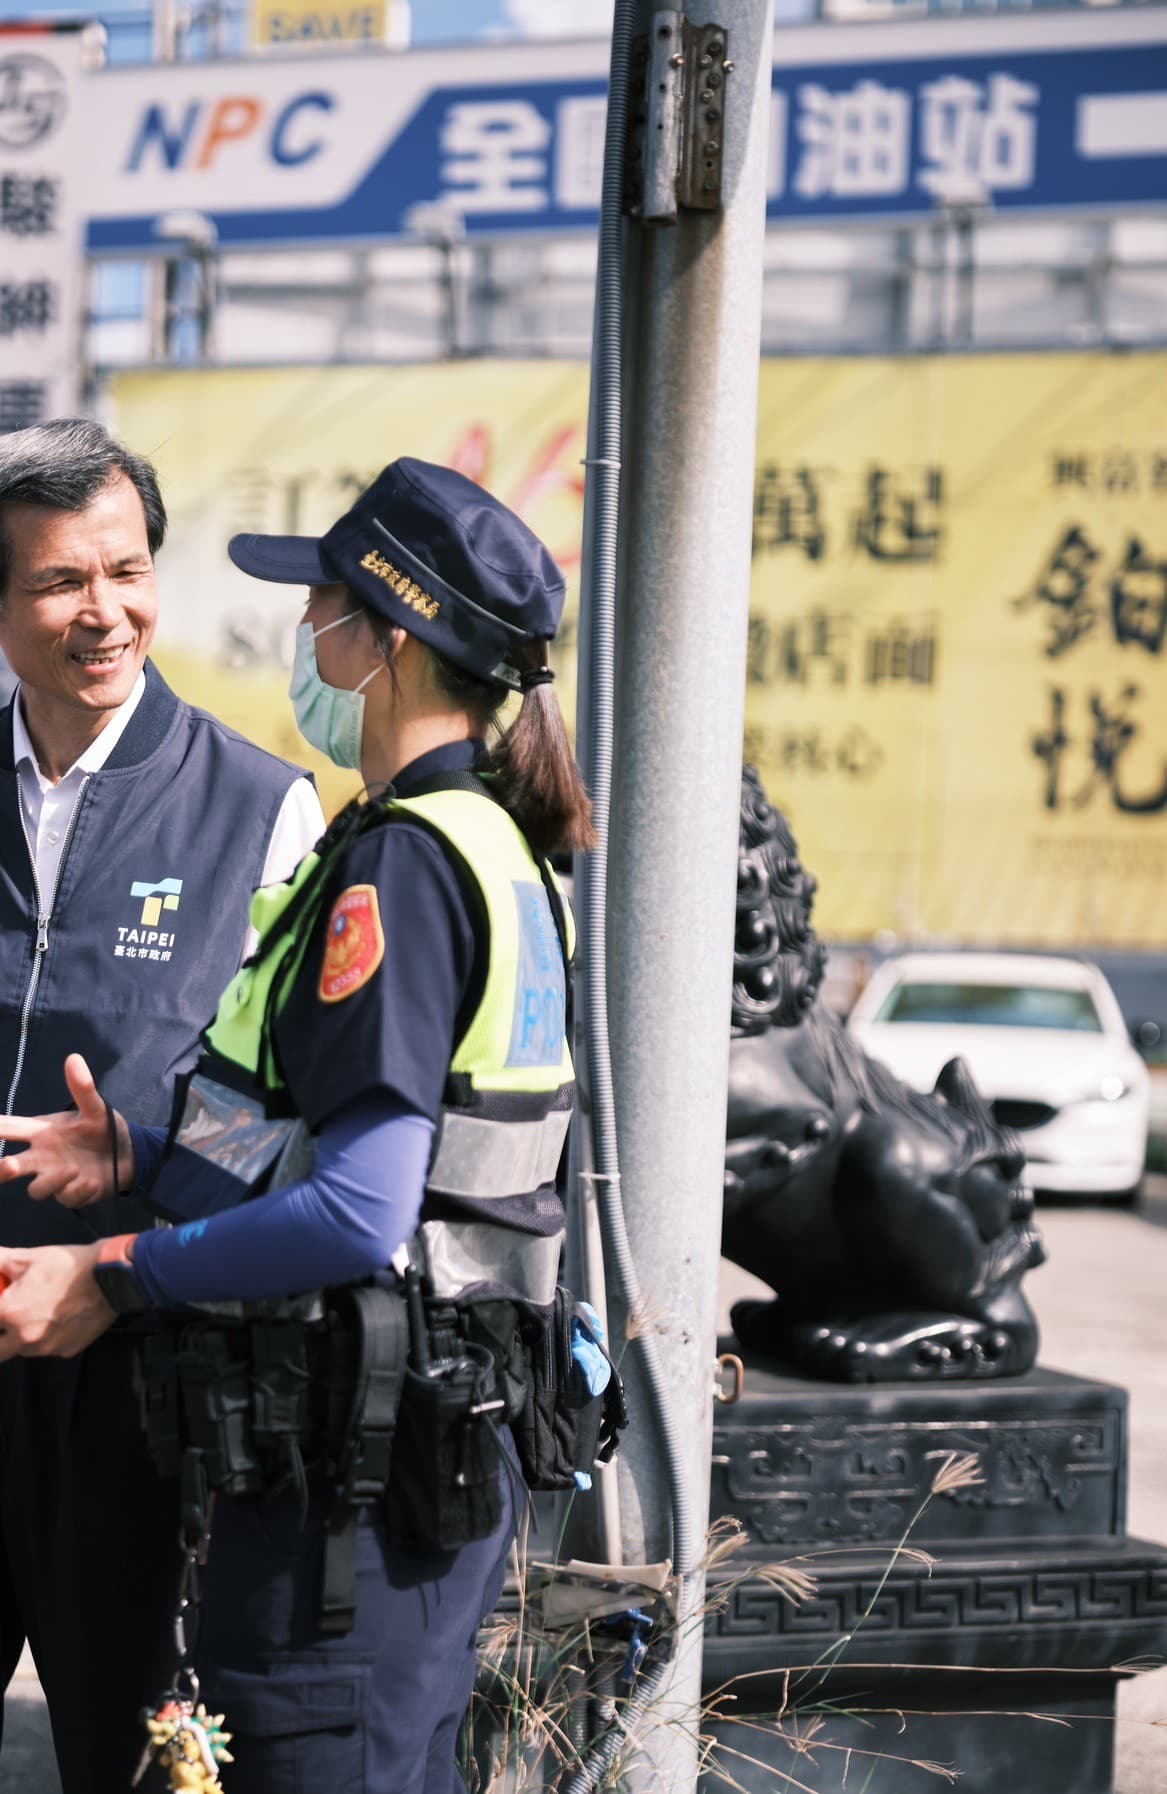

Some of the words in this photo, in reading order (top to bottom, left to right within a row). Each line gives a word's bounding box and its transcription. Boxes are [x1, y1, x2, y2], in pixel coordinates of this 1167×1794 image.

[125, 91, 338, 174] NPC
[748, 608, 938, 686] 店面
[113, 944, 173, 963] 臺北市政府
[117, 926, 176, 949] TAIPEI
